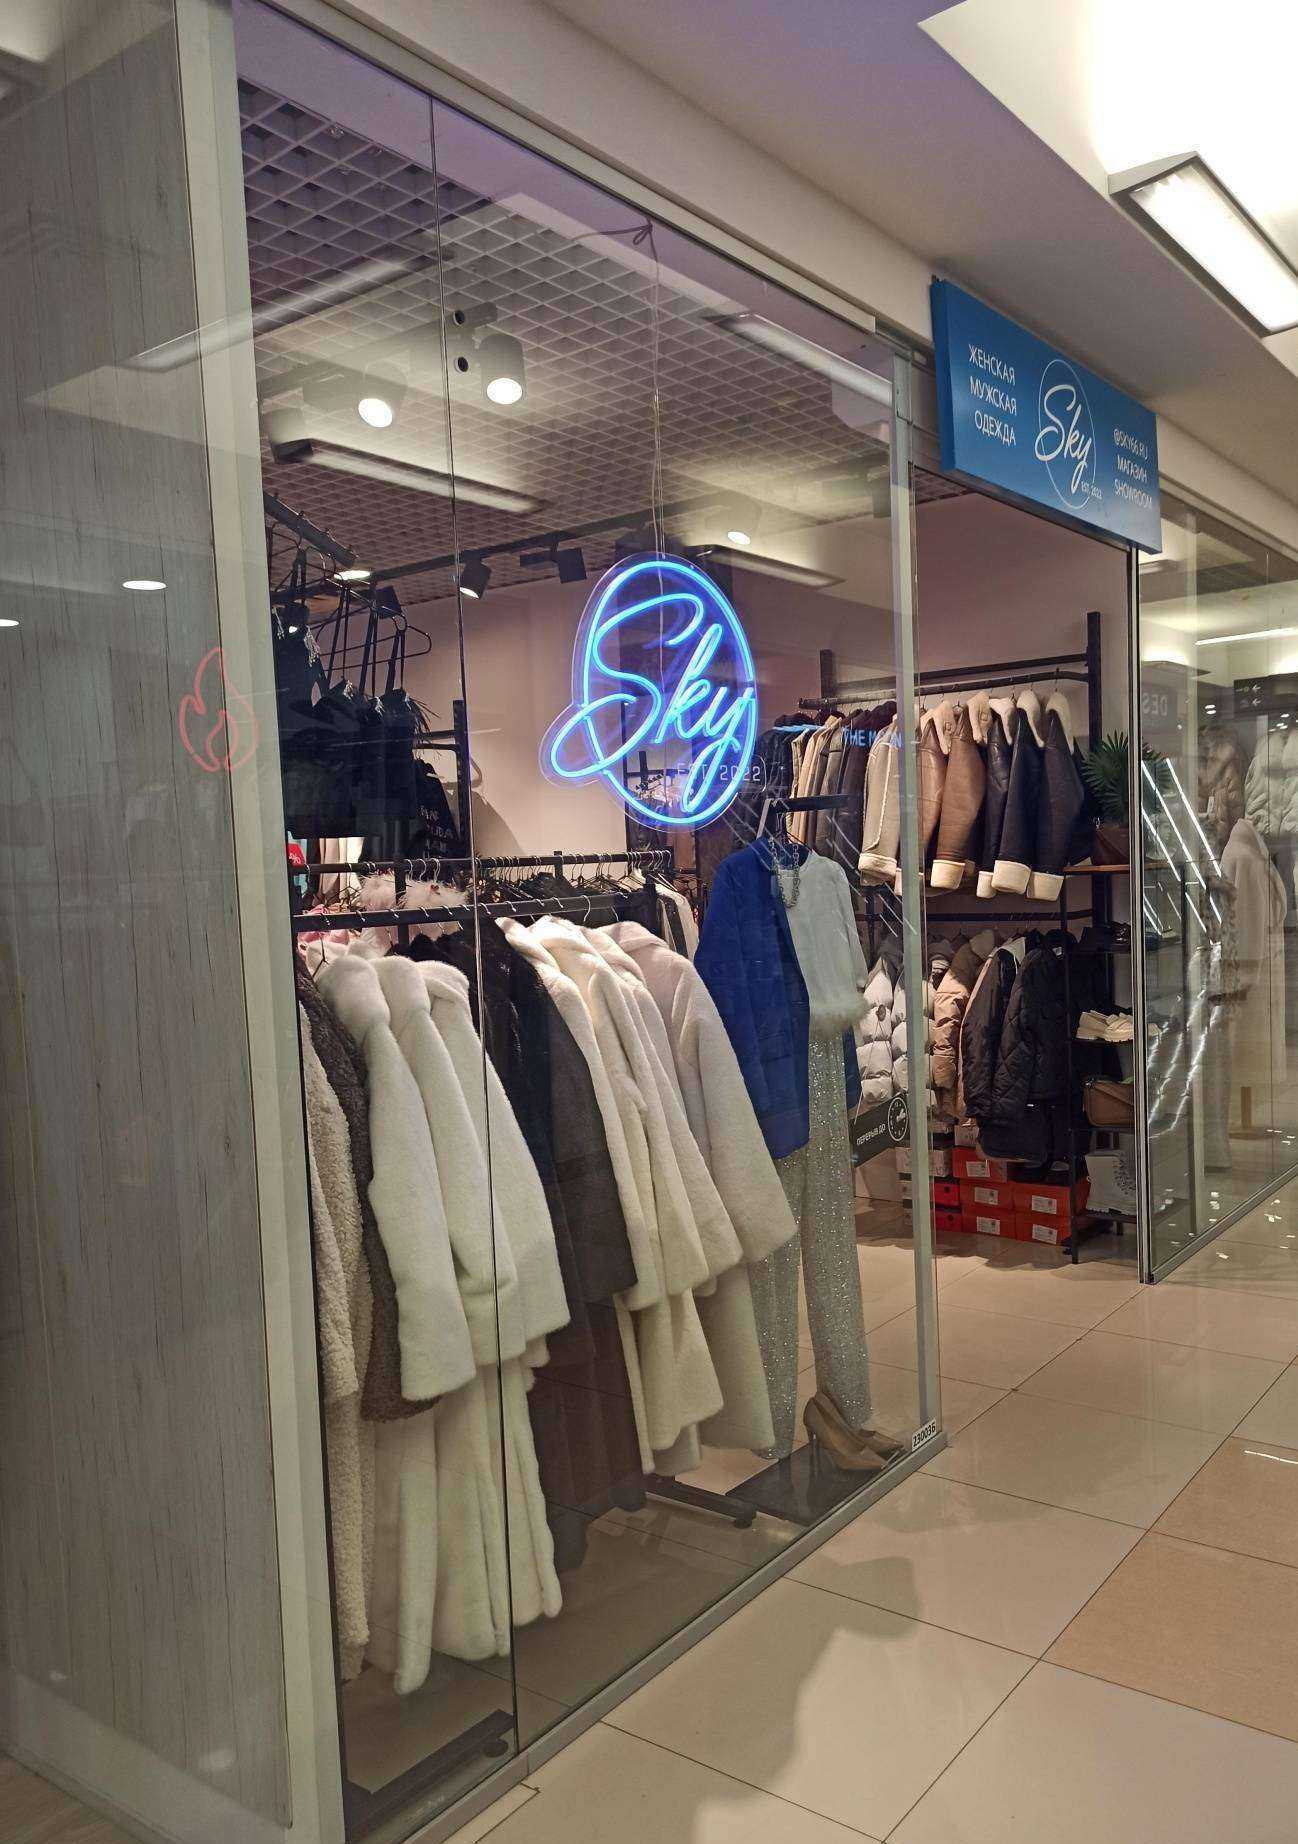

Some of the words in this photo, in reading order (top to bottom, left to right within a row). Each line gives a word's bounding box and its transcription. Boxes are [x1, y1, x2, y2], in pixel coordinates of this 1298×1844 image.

[968, 344, 1015, 386] ЖЕНСКАЯ
[970, 375, 1017, 416] МУЖСКАЯ
[975, 409, 1017, 447] ОДЕЖДА
[1034, 384, 1093, 494] Sky
[1117, 453, 1148, 483] МАГАЗИН
[1114, 478, 1152, 510] SHOWROOM
[549, 592, 755, 814] Sky
